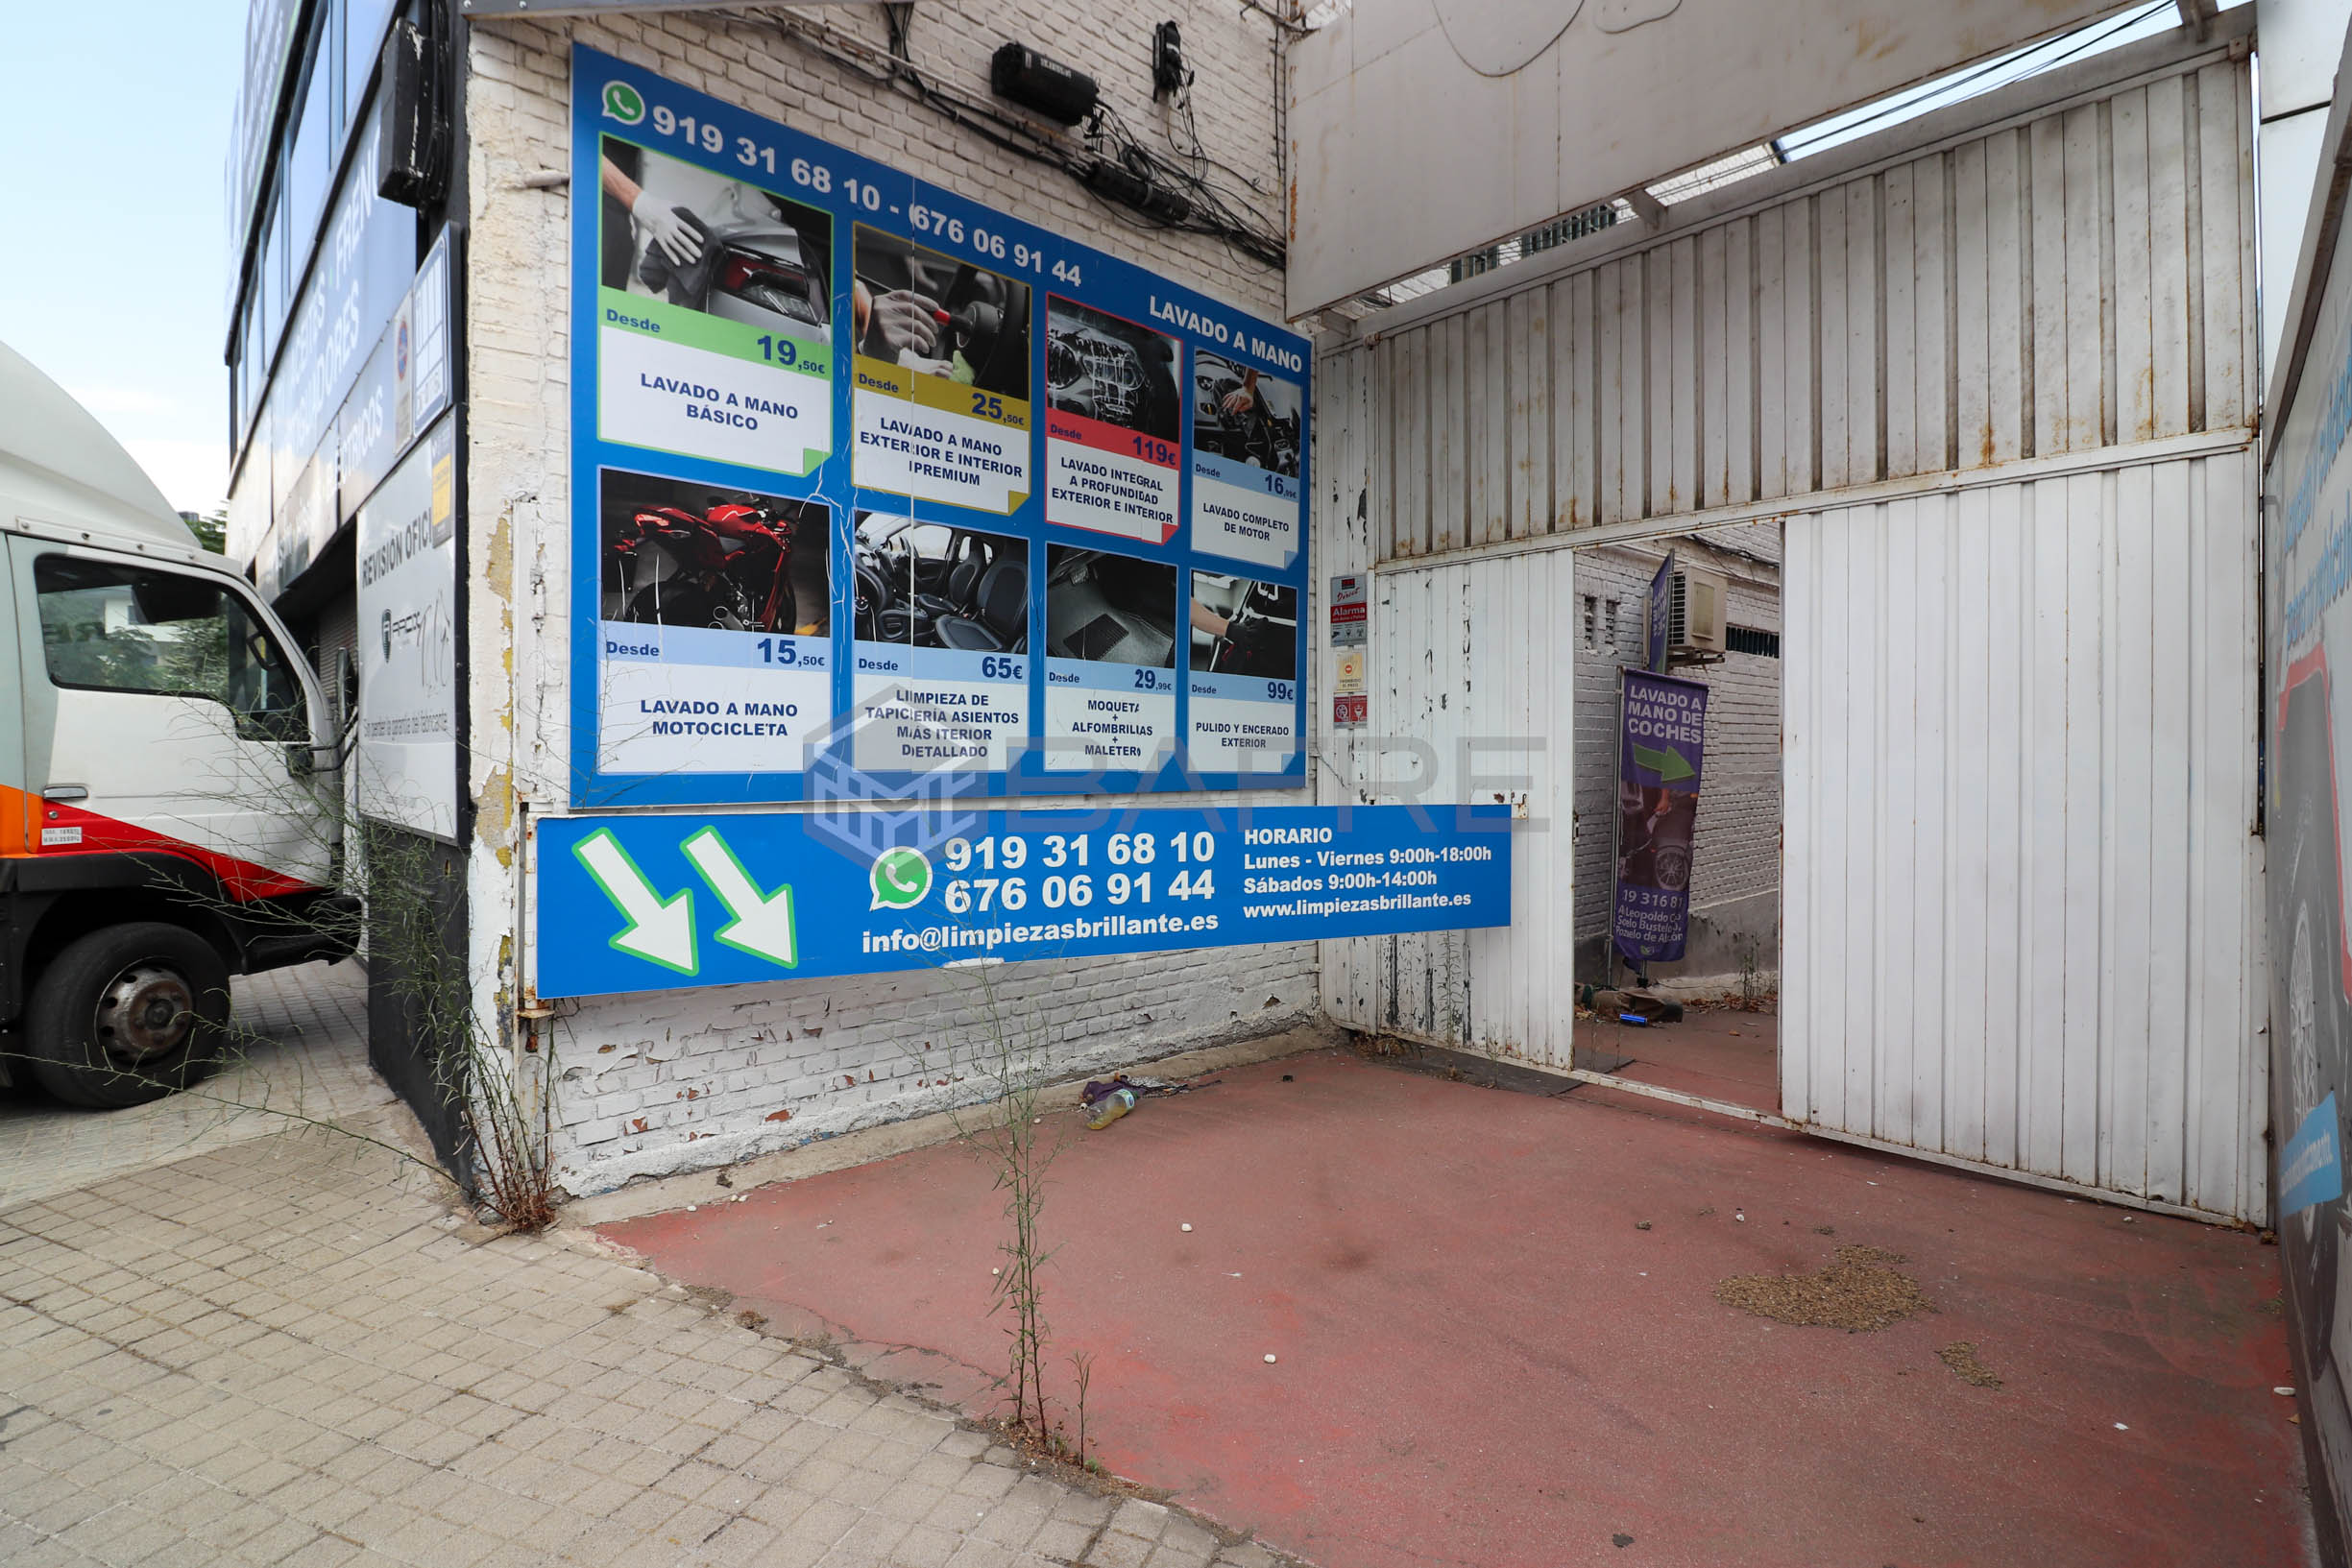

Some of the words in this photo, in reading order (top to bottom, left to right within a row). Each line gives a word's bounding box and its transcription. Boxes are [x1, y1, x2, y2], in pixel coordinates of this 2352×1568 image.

[653, 106, 723, 154] 919
[737, 137, 775, 175] 31
[791, 158, 832, 193] 68
[844, 179, 881, 212] 10
[909, 204, 964, 244] 676
[973, 229, 1006, 259] 06
[1014, 244, 1042, 273] 91
[1052, 260, 1081, 287] 44
[606, 308, 661, 333] Desde
[1150, 296, 1228, 343] LAVADO
[1233, 331, 1247, 351] A
[1251, 337, 1302, 374] MANO
[757, 335, 825, 374] 19,50€
[859, 373, 899, 393] Desde
[641, 373, 720, 401] LAVADO
[726, 393, 739, 407] A
[744, 397, 798, 420] MANO
[686, 403, 758, 430] BÁSICO
[972, 393, 1025, 426] 25,50€
[881, 417, 943, 443] LAVADO
[948, 434, 958, 446] A
[961, 437, 1003, 456] MANO
[1051, 423, 1082, 440] Desde
[861, 431, 940, 460] EXTERIOR
[945, 450, 954, 463] E
[958, 453, 1023, 478] INTERIOR
[1133, 435, 1176, 466] 119€
[911, 461, 981, 486] PREMIUM
[1061, 457, 1107, 477] LAVADO
[1110, 469, 1163, 492] INTEGRAL
[1196, 463, 1221, 477] Desde
[1069, 475, 1078, 486] A
[1081, 478, 1158, 505] PROFUNDIDAD
[1052, 487, 1111, 509] EXTERIOR
[1114, 501, 1121, 512] E
[1125, 503, 1174, 523] INTERIOR
[1203, 502, 1240, 519] LAVADO
[1243, 513, 1289, 532] COMPLETO
[1224, 522, 1236, 533] DE
[1239, 525, 1270, 541] MOTOR
[363, 531, 402, 589] REVISION
[405, 507, 432, 560] OFICI
[1334, 607, 1365, 616] Alarma
[606, 641, 660, 656] Desde
[757, 638, 825, 667] 15,50€
[859, 659, 899, 671] Desde
[982, 656, 1023, 680] 65€
[1049, 672, 1080, 684] Desde
[1134, 669, 1172, 691] 29,99€
[1192, 684, 1217, 695] Desde
[896, 689, 967, 705] LIMPIEZA
[972, 695, 988, 706] DE
[1267, 681, 1294, 700] 99€
[1630, 685, 1687, 708] LAVADO
[1691, 698, 1702, 711] A
[641, 700, 719, 715] LAVADO
[726, 702, 739, 715] A
[745, 703, 798, 717] MANO
[865, 707, 947, 723] TAPICERÍA
[952, 712, 1019, 724] ASIENTOS
[1628, 701, 1677, 721] MANO
[1682, 711, 1703, 726] DE
[652, 721, 788, 736] MOTOCICLETA
[897, 726, 932, 740] MÁS
[1196, 722, 1230, 733] PULIDO
[1234, 724, 1240, 733] Y
[1243, 725, 1289, 736] ENCERADO
[1628, 717, 1702, 744] COCHES
[902, 744, 987, 758] DETALLADO
[1222, 737, 1266, 748] EXTERIOR
[1245, 828, 1333, 845] HORARIO
[945, 836, 1027, 872] 919
[1042, 834, 1089, 869] 31
[1107, 832, 1155, 865] 68
[1170, 832, 1215, 863] 10
[1245, 853, 1300, 870] Lunes
[1317, 849, 1385, 867] Viernes
[1389, 846, 1491, 864] 9:00h-18:00h
[945, 877, 1027, 914] 676
[1042, 874, 1093, 908] 06
[1107, 871, 1152, 905] 91
[1168, 869, 1215, 901] 44
[1244, 875, 1323, 894] Sábados
[1328, 870, 1438, 890] 9:00h-14:00h
[1243, 892, 1471, 918] www.limpiezasbrillante.es
[862, 913, 1219, 953] info@limpiezasbrillante.es
[1644, 931, 1657, 942] de
